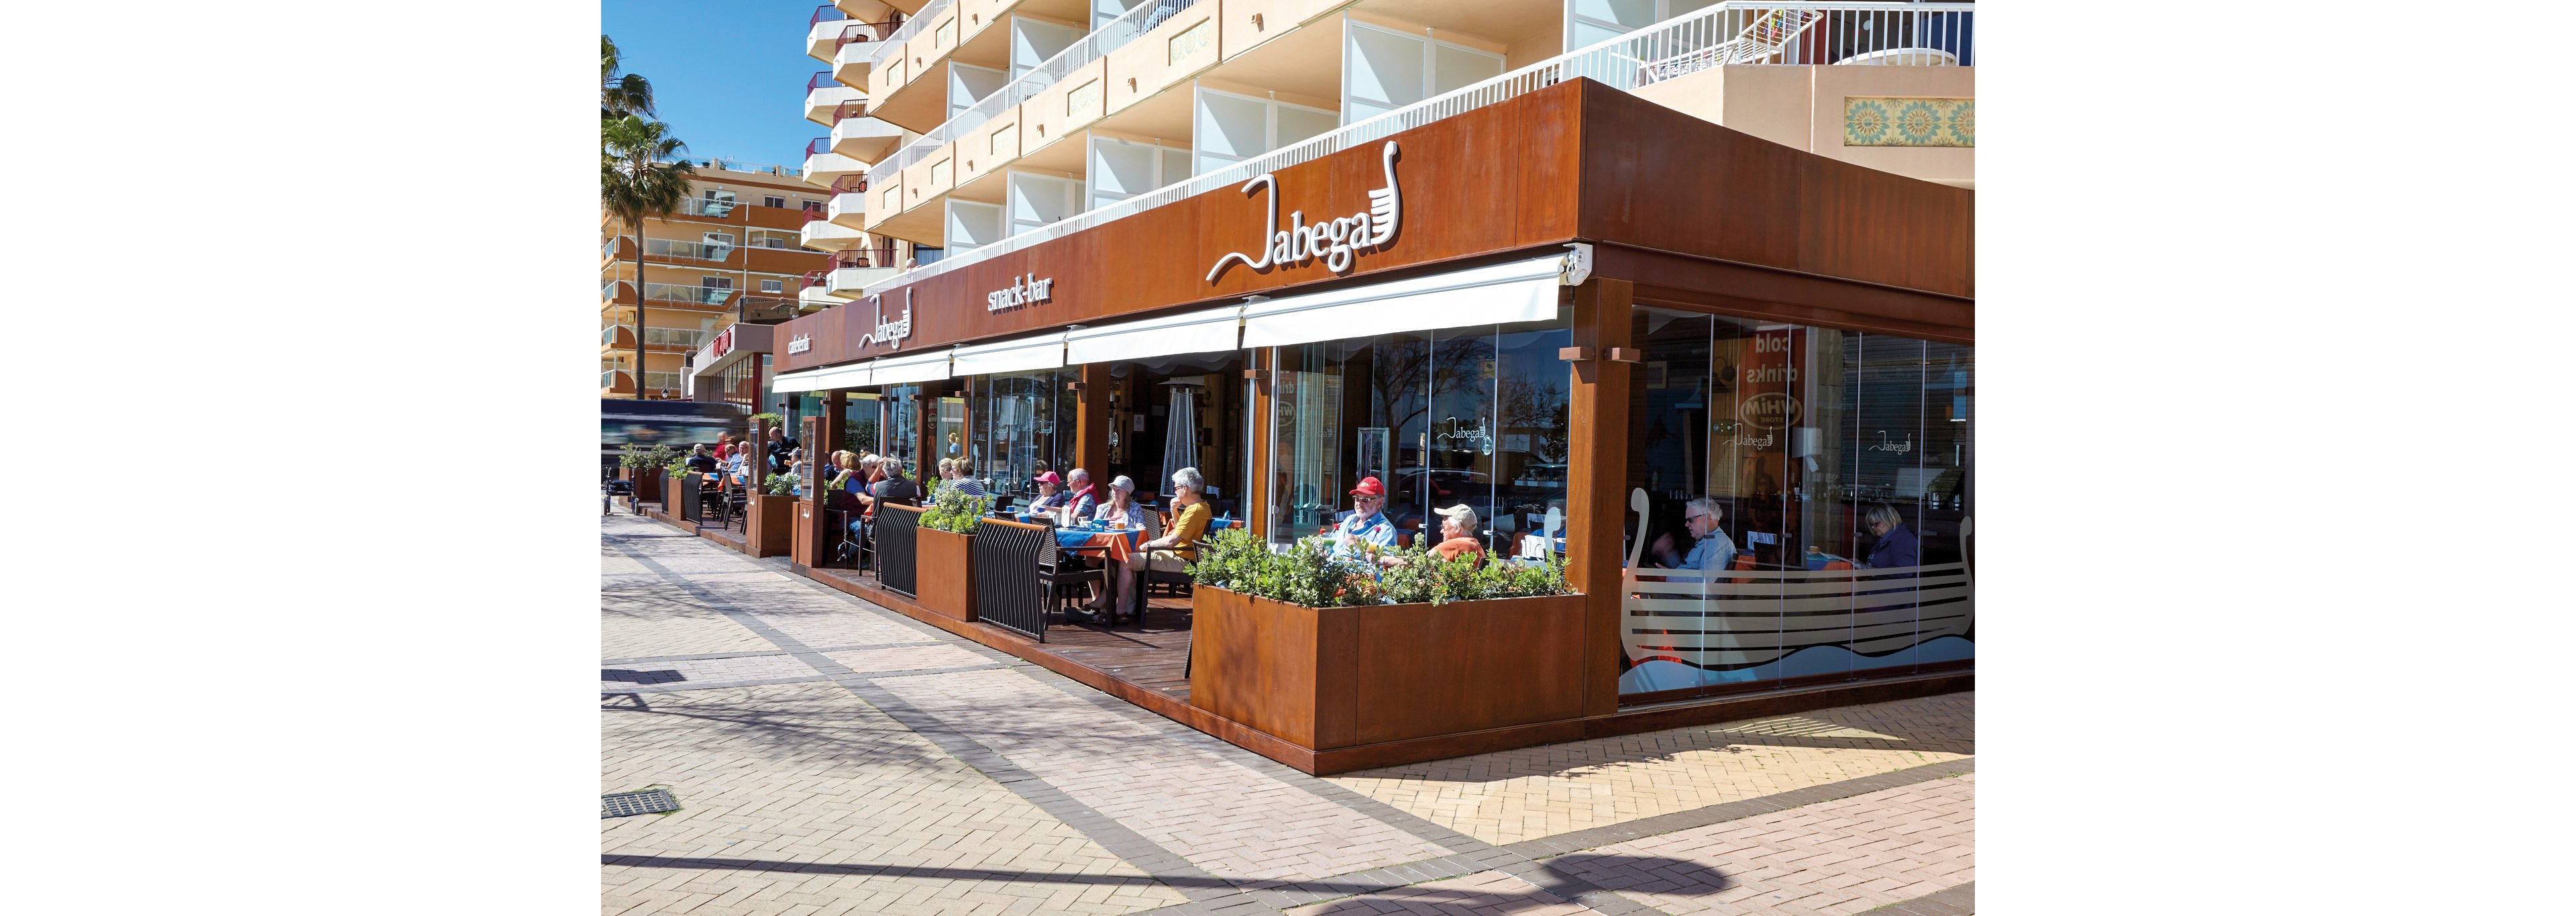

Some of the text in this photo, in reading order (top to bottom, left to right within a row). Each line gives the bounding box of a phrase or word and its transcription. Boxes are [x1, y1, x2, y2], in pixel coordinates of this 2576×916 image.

[1205, 173, 1374, 281] Jabega
[987, 272, 1053, 311] snack-bar
[859, 293, 904, 349] Jabega
[1437, 417, 1480, 442] Jabega
[1723, 423, 1768, 450] Jabega
[1868, 430, 1906, 456] Jabega
